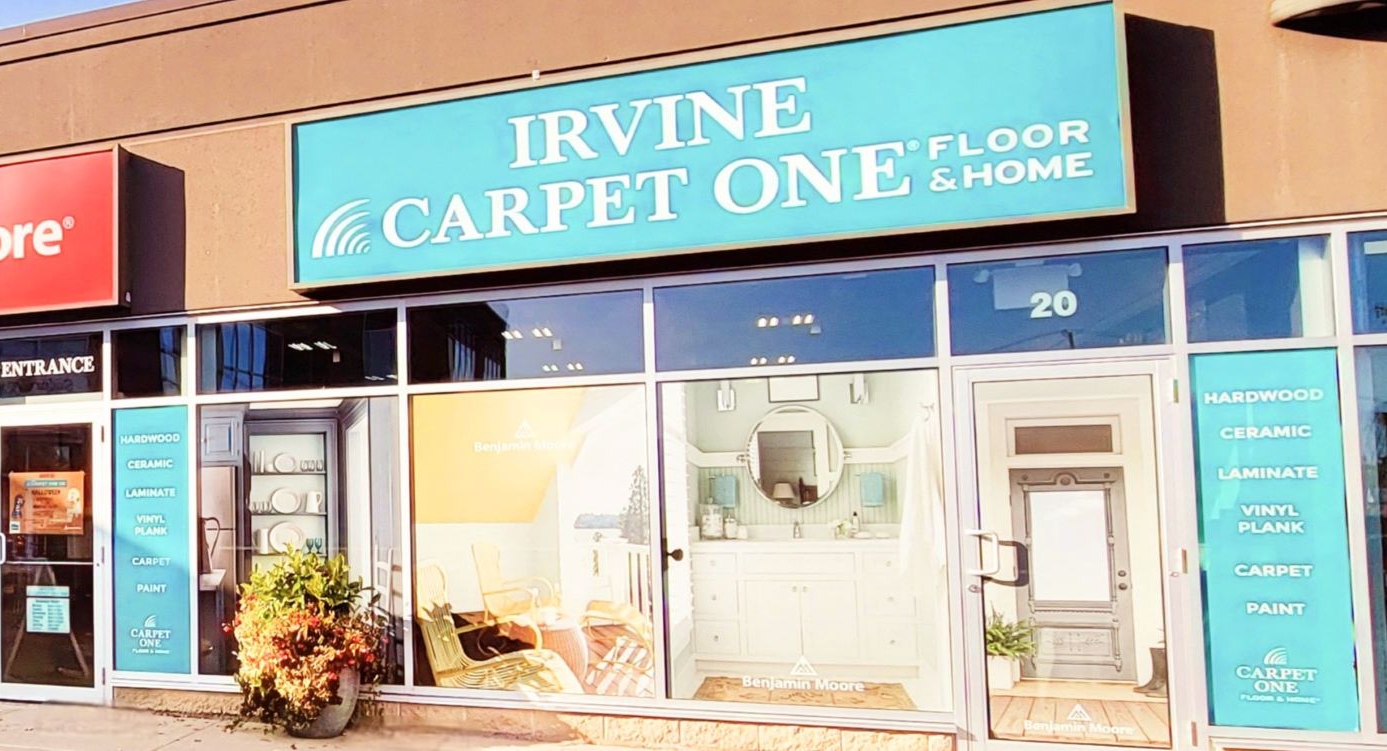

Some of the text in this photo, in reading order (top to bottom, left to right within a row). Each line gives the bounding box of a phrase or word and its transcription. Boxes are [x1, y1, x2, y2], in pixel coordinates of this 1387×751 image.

[504, 76, 813, 169] IRVINE
[928, 118, 1091, 160] FLOOR
[928, 150, 1094, 193] &HOME
[381, 169, 689, 249] CARPET
[1029, 289, 1078, 319] 20
[1, 355, 95, 378] ENTRANCE
[1203, 387, 1324, 405] HARDWOOD
[120, 433, 180, 444] HARDWOOD
[1219, 424, 1311, 440] CERAMIC
[127, 459, 173, 469] CERAMIC
[1218, 465, 1319, 480] LAMINATE
[125, 488, 175, 498] LAMINATE
[1240, 504, 1299, 517] VINYL
[136, 515, 165, 524] VINYL
[134, 527, 168, 536] PLANK
[1238, 520, 1304, 534] PLANK
[132, 557, 171, 566] CARPET
[1234, 563, 1313, 578] CARPET
[137, 584, 167, 593] PAINT
[1246, 602, 1306, 616] PAINT
[130, 628, 172, 639] CARPET
[139, 638, 162, 648] ONE
[1236, 665, 1317, 681] CARPET
[741, 675, 865, 692] Benjamin Moore
[1254, 680, 1298, 693] ONE
[1023, 719, 1135, 736] Benjamin Moore
